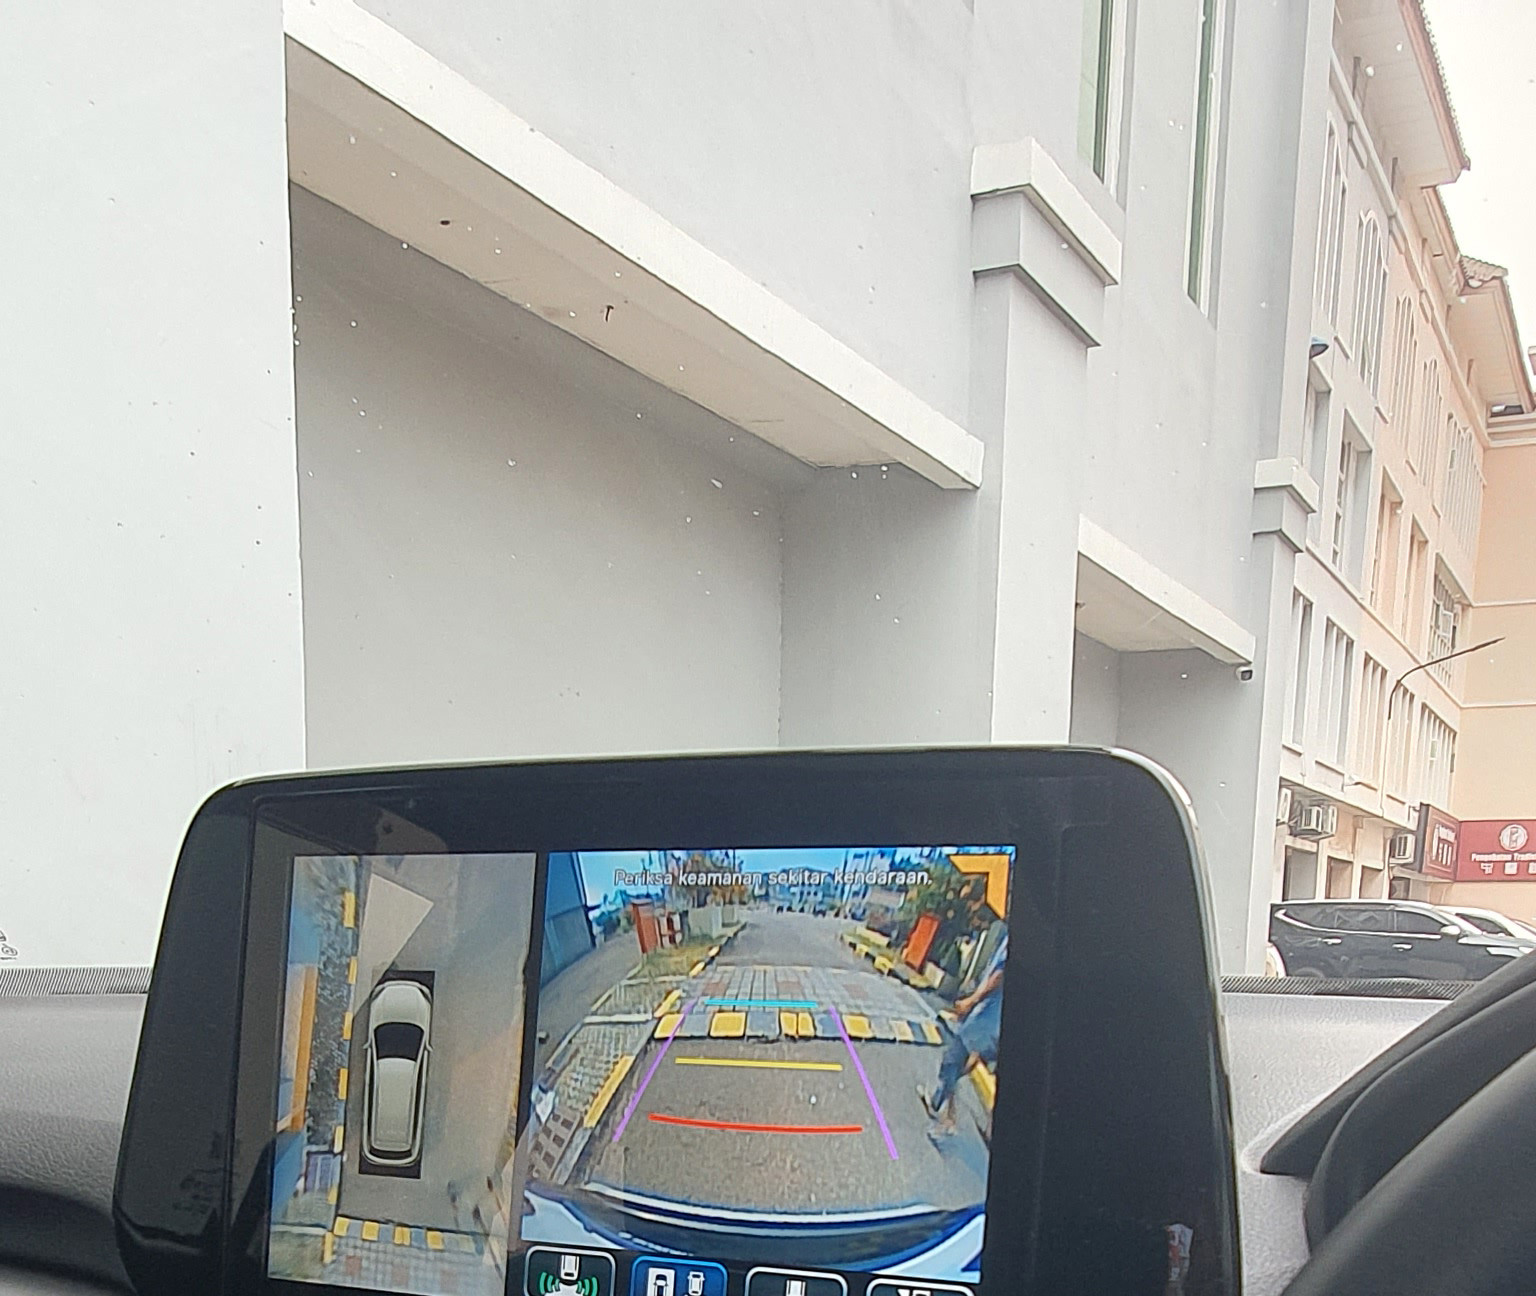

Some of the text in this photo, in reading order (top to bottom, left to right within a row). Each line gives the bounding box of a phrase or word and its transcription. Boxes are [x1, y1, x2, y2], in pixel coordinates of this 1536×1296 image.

[614, 869, 933, 886] Periksa keamanan sekitar kendaraan.
